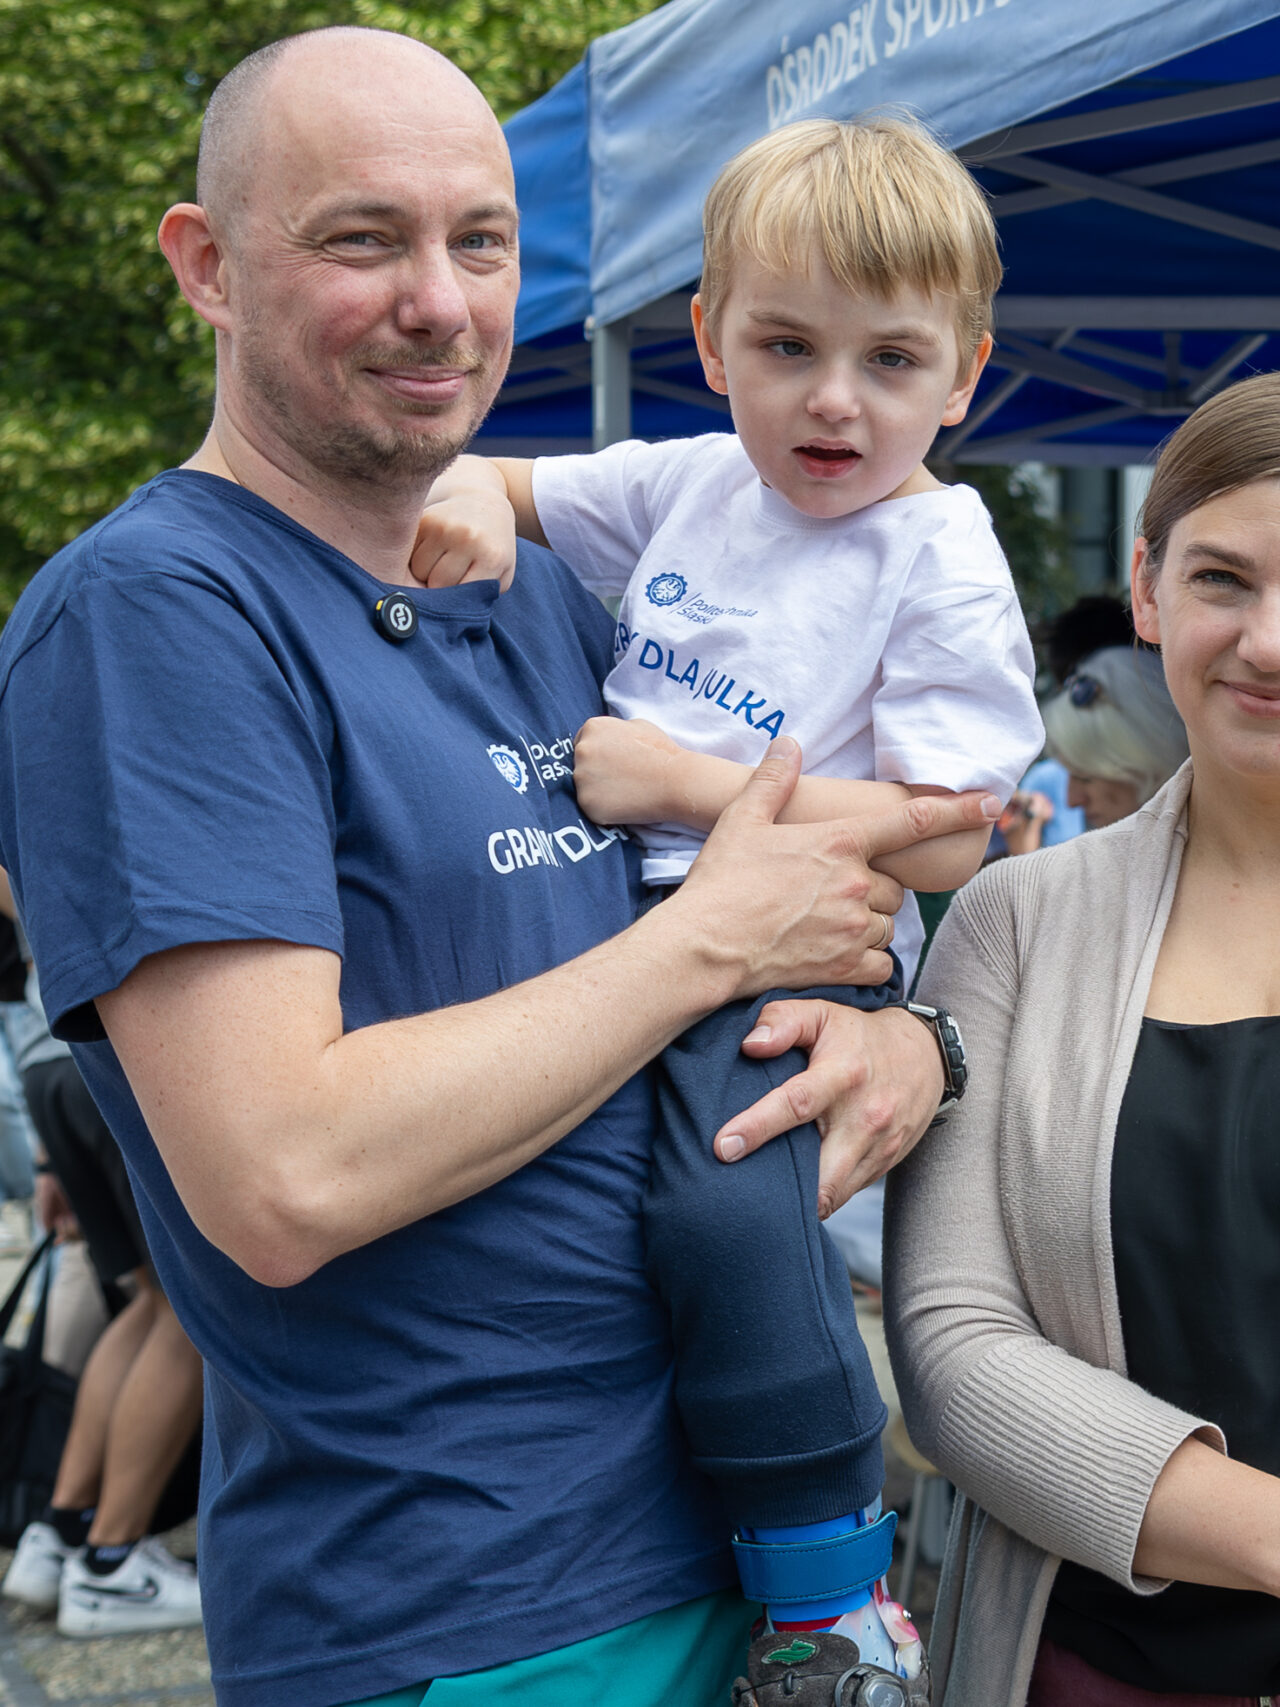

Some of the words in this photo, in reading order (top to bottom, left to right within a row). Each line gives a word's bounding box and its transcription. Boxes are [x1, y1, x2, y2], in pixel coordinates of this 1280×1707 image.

[766, 0, 880, 130] OŚRODEK
[884, 0, 1008, 58] SPO
[638, 638, 699, 691] DLA
